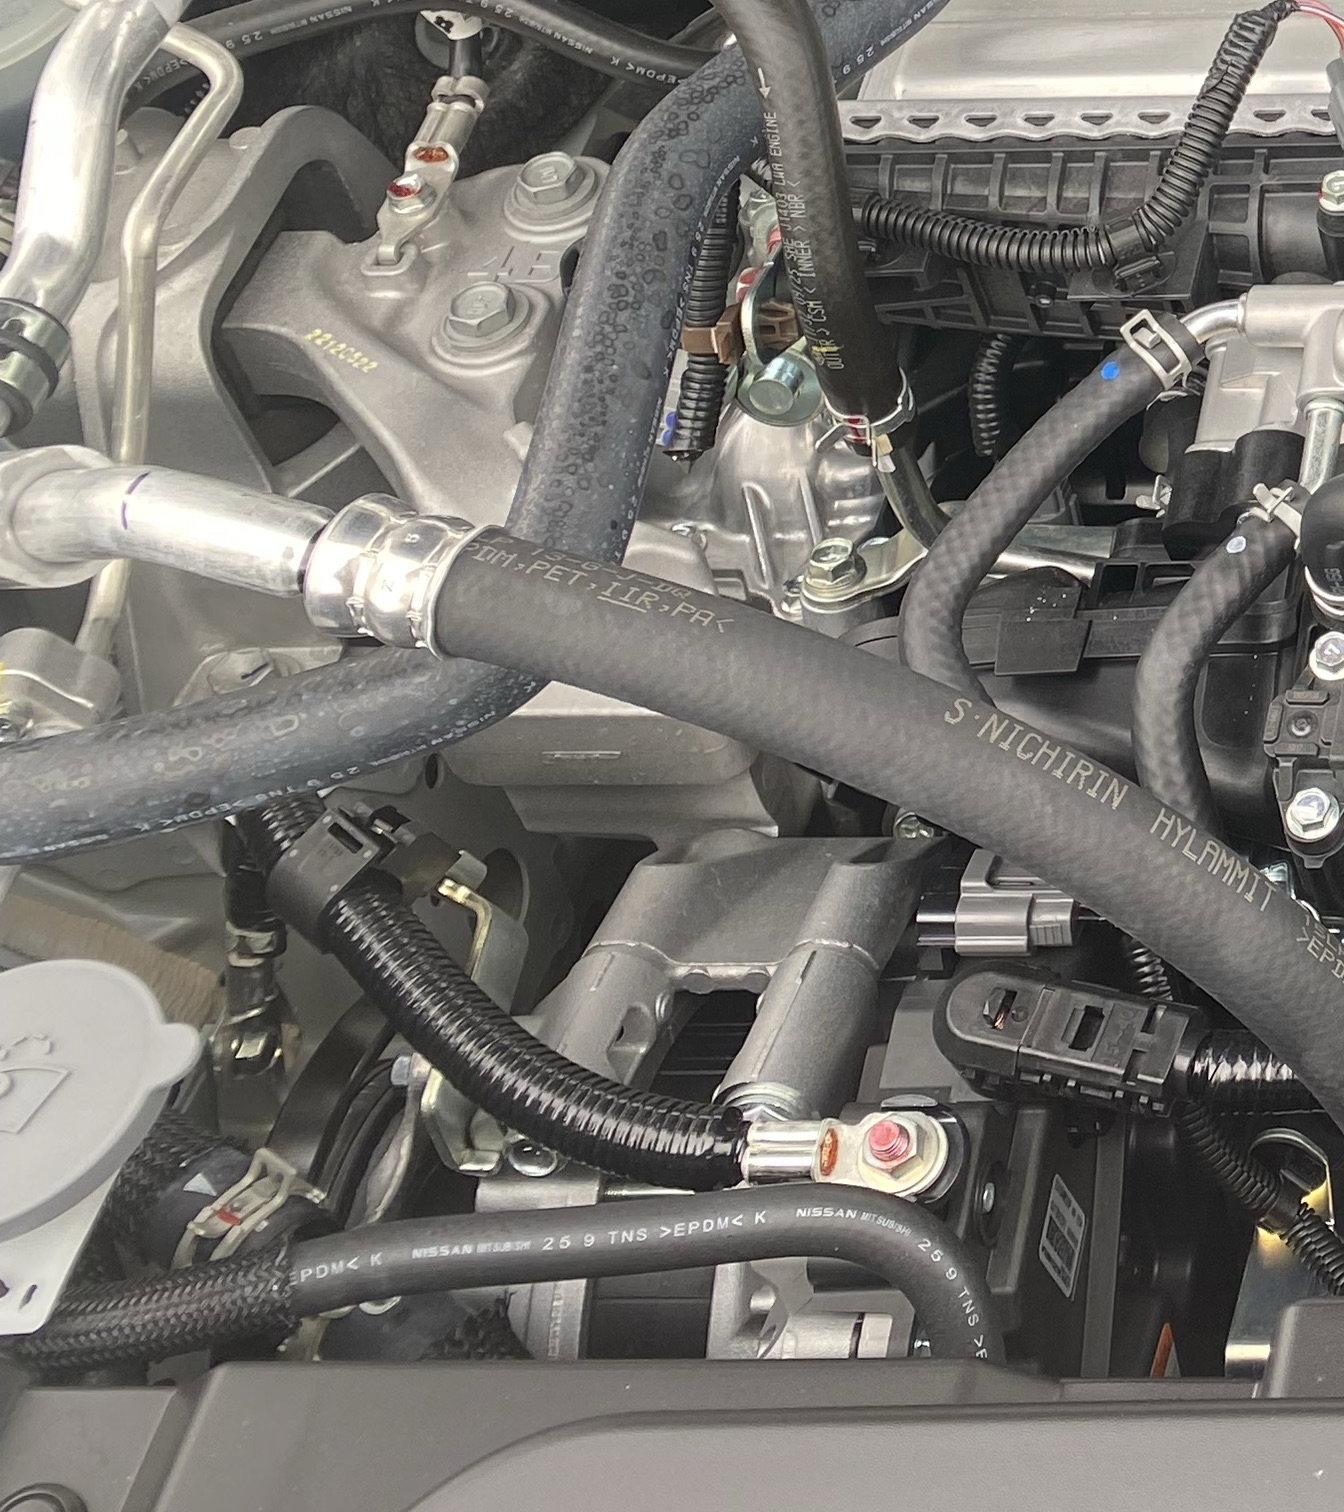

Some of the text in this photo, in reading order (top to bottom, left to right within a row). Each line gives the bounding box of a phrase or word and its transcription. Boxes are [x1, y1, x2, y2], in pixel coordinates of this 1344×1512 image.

[552, 31, 594, 56] NISSAN
[763, 111, 784, 157] ENGINE
[793, 239, 817, 278] INNER
[1150, 807, 1277, 913] HYLAMMIT
[370, 1251, 384, 1266] K
[412, 1243, 474, 1260] NISSAN
[607, 1227, 649, 1246] TNS
[659, 1214, 744, 1239] >EPDM<
[754, 1210, 768, 1225] K
[795, 1207, 858, 1220] NISSAN
[860, 1211, 912, 1238] MITSUBISHI
[957, 1285, 981, 1327] TNS
